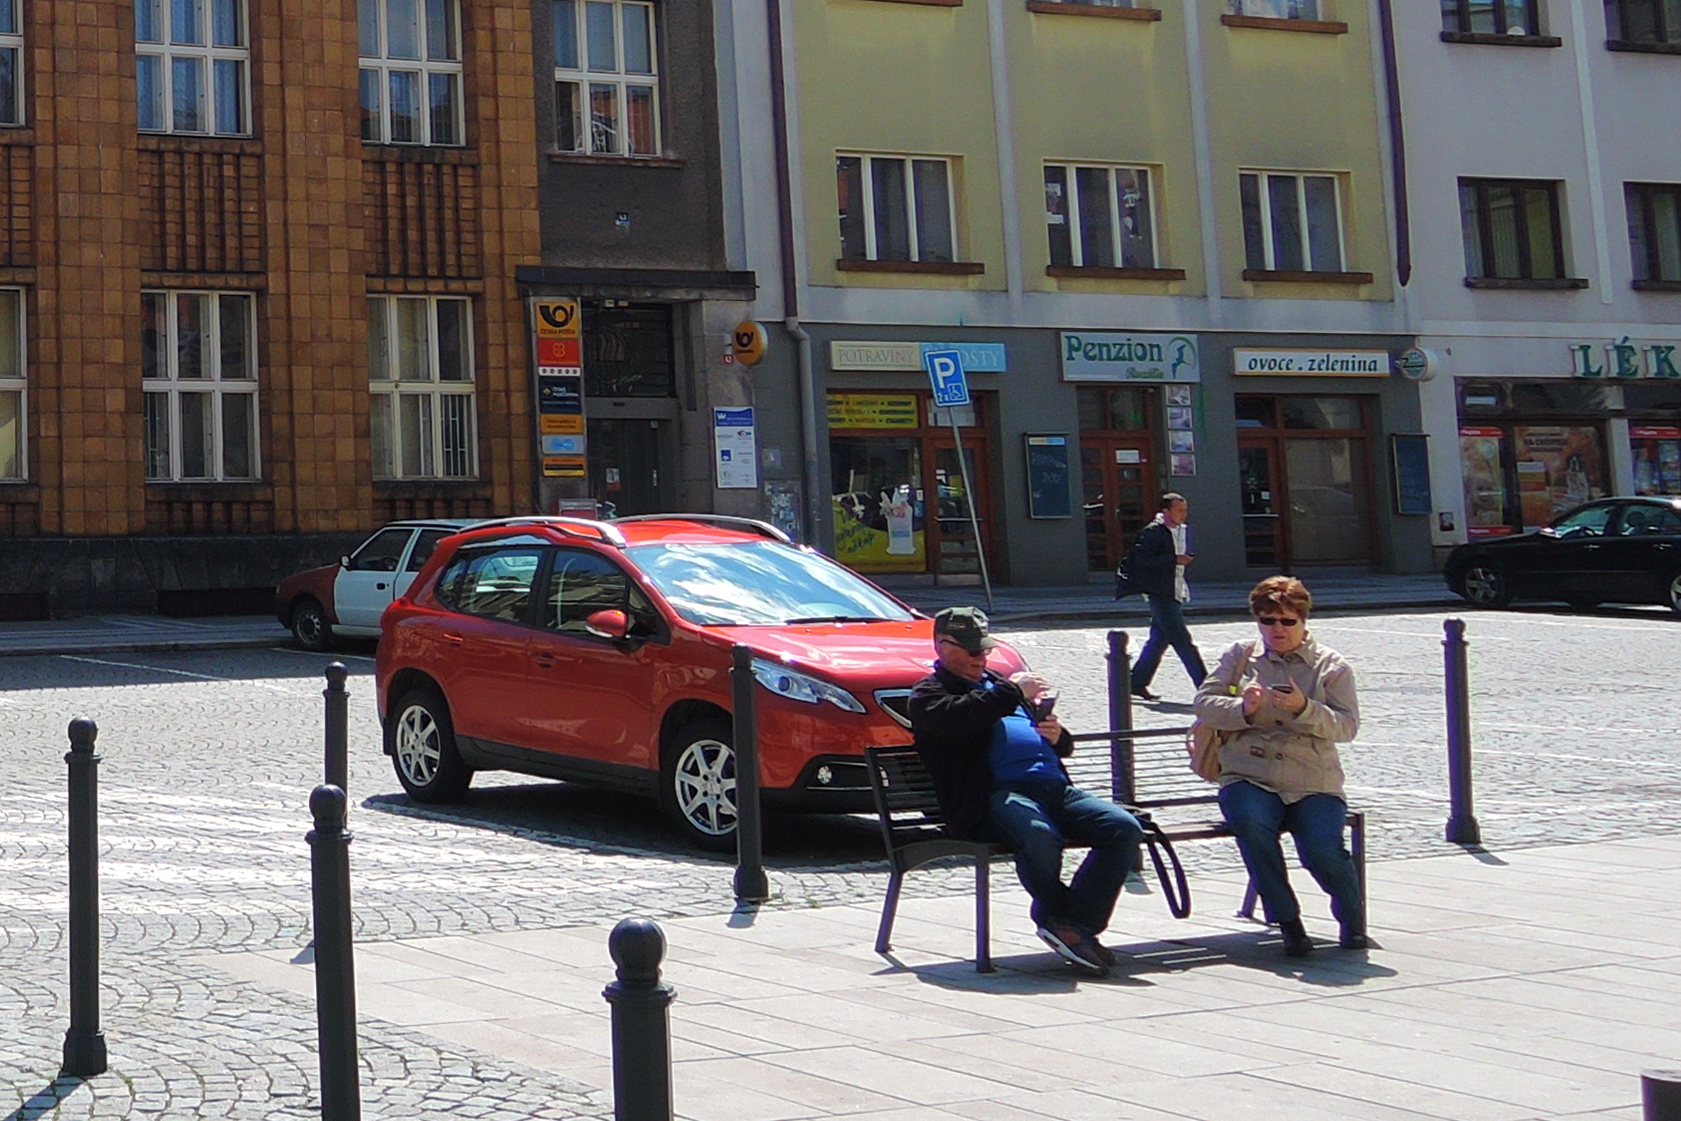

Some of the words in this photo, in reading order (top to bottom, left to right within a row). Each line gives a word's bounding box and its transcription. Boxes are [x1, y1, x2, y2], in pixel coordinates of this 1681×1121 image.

[838, 348, 915, 363] POTRAVINY
[1064, 335, 1164, 362] Penzion
[934, 357, 956, 389] P
[1248, 356, 1294, 371] ovoce
[1307, 353, 1378, 372] zelenina
